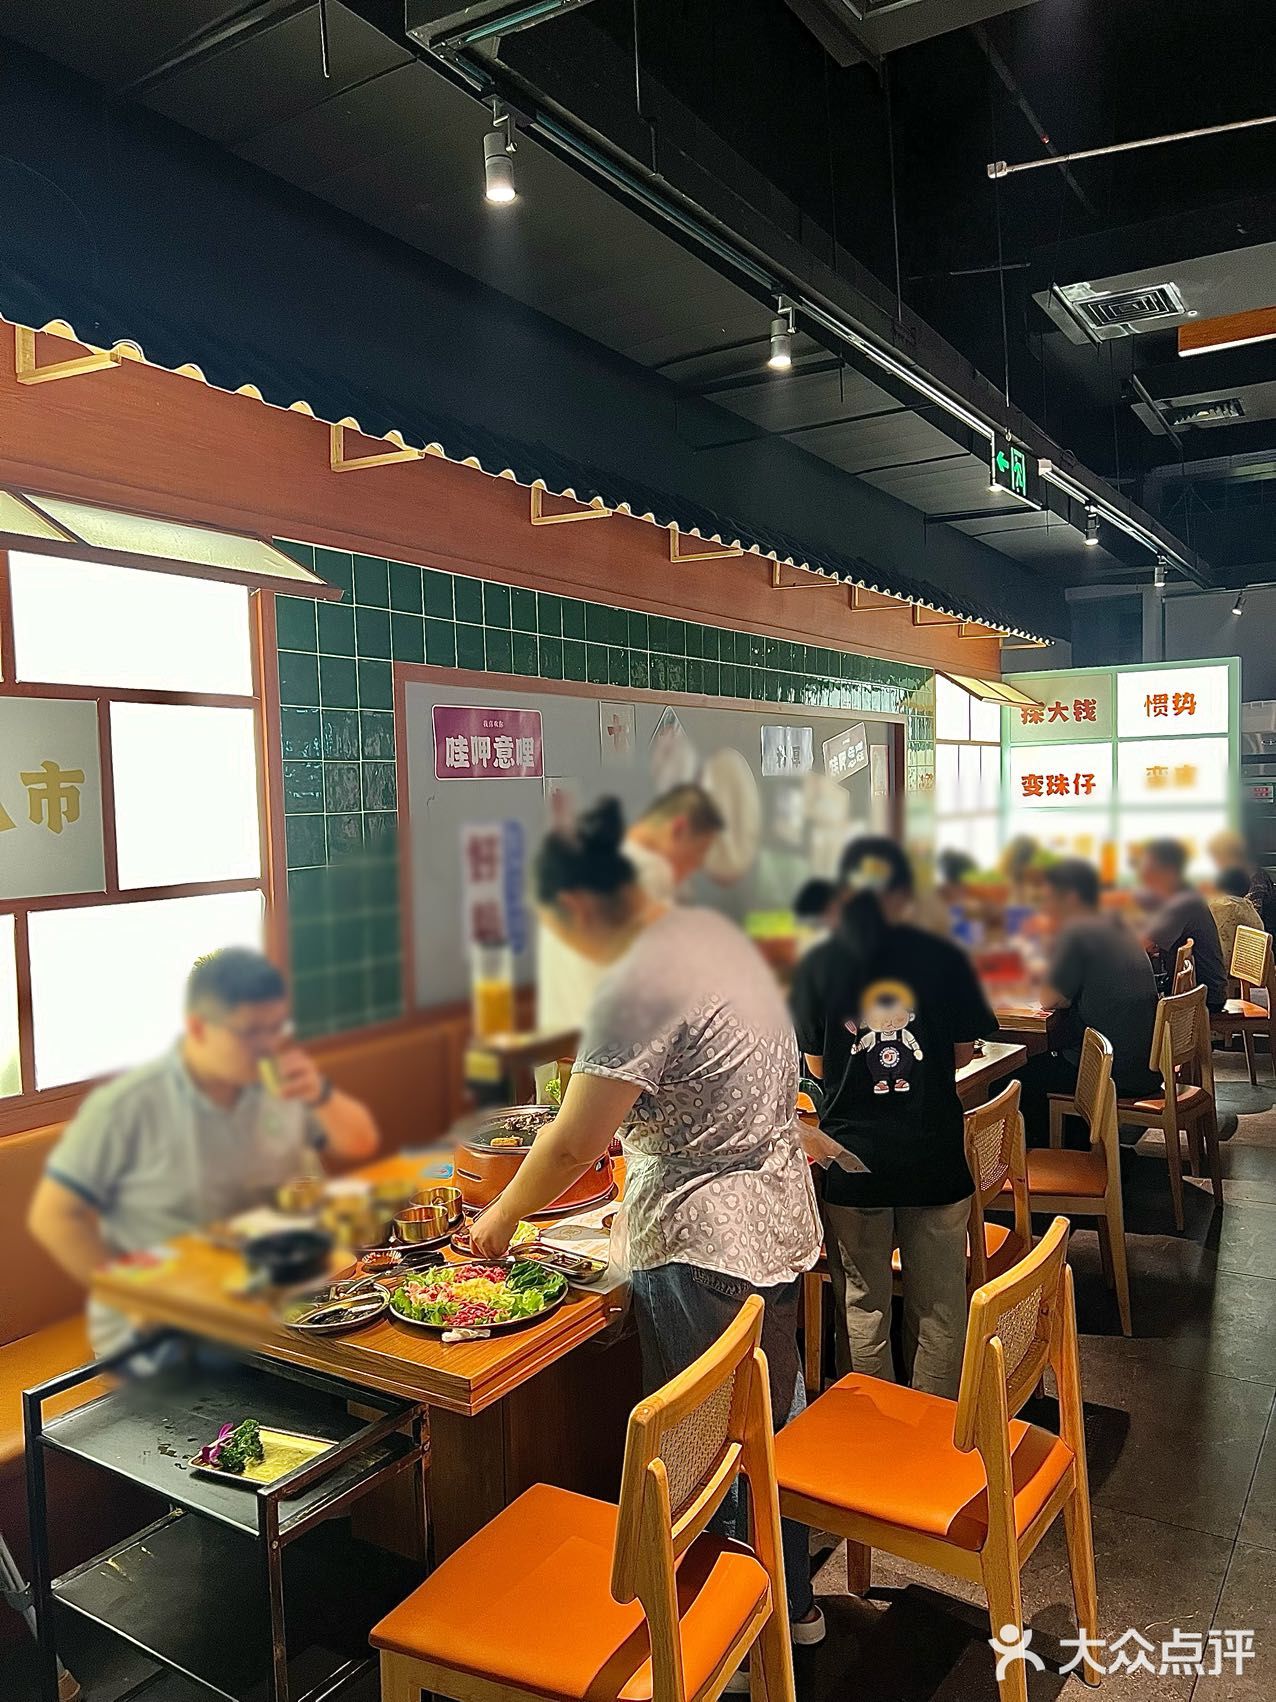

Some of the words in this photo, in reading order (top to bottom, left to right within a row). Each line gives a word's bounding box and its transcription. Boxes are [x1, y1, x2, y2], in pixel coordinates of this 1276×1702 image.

[445, 735, 535, 769] 哇呷意哩
[1021, 773, 1097, 797] 变珠仔
